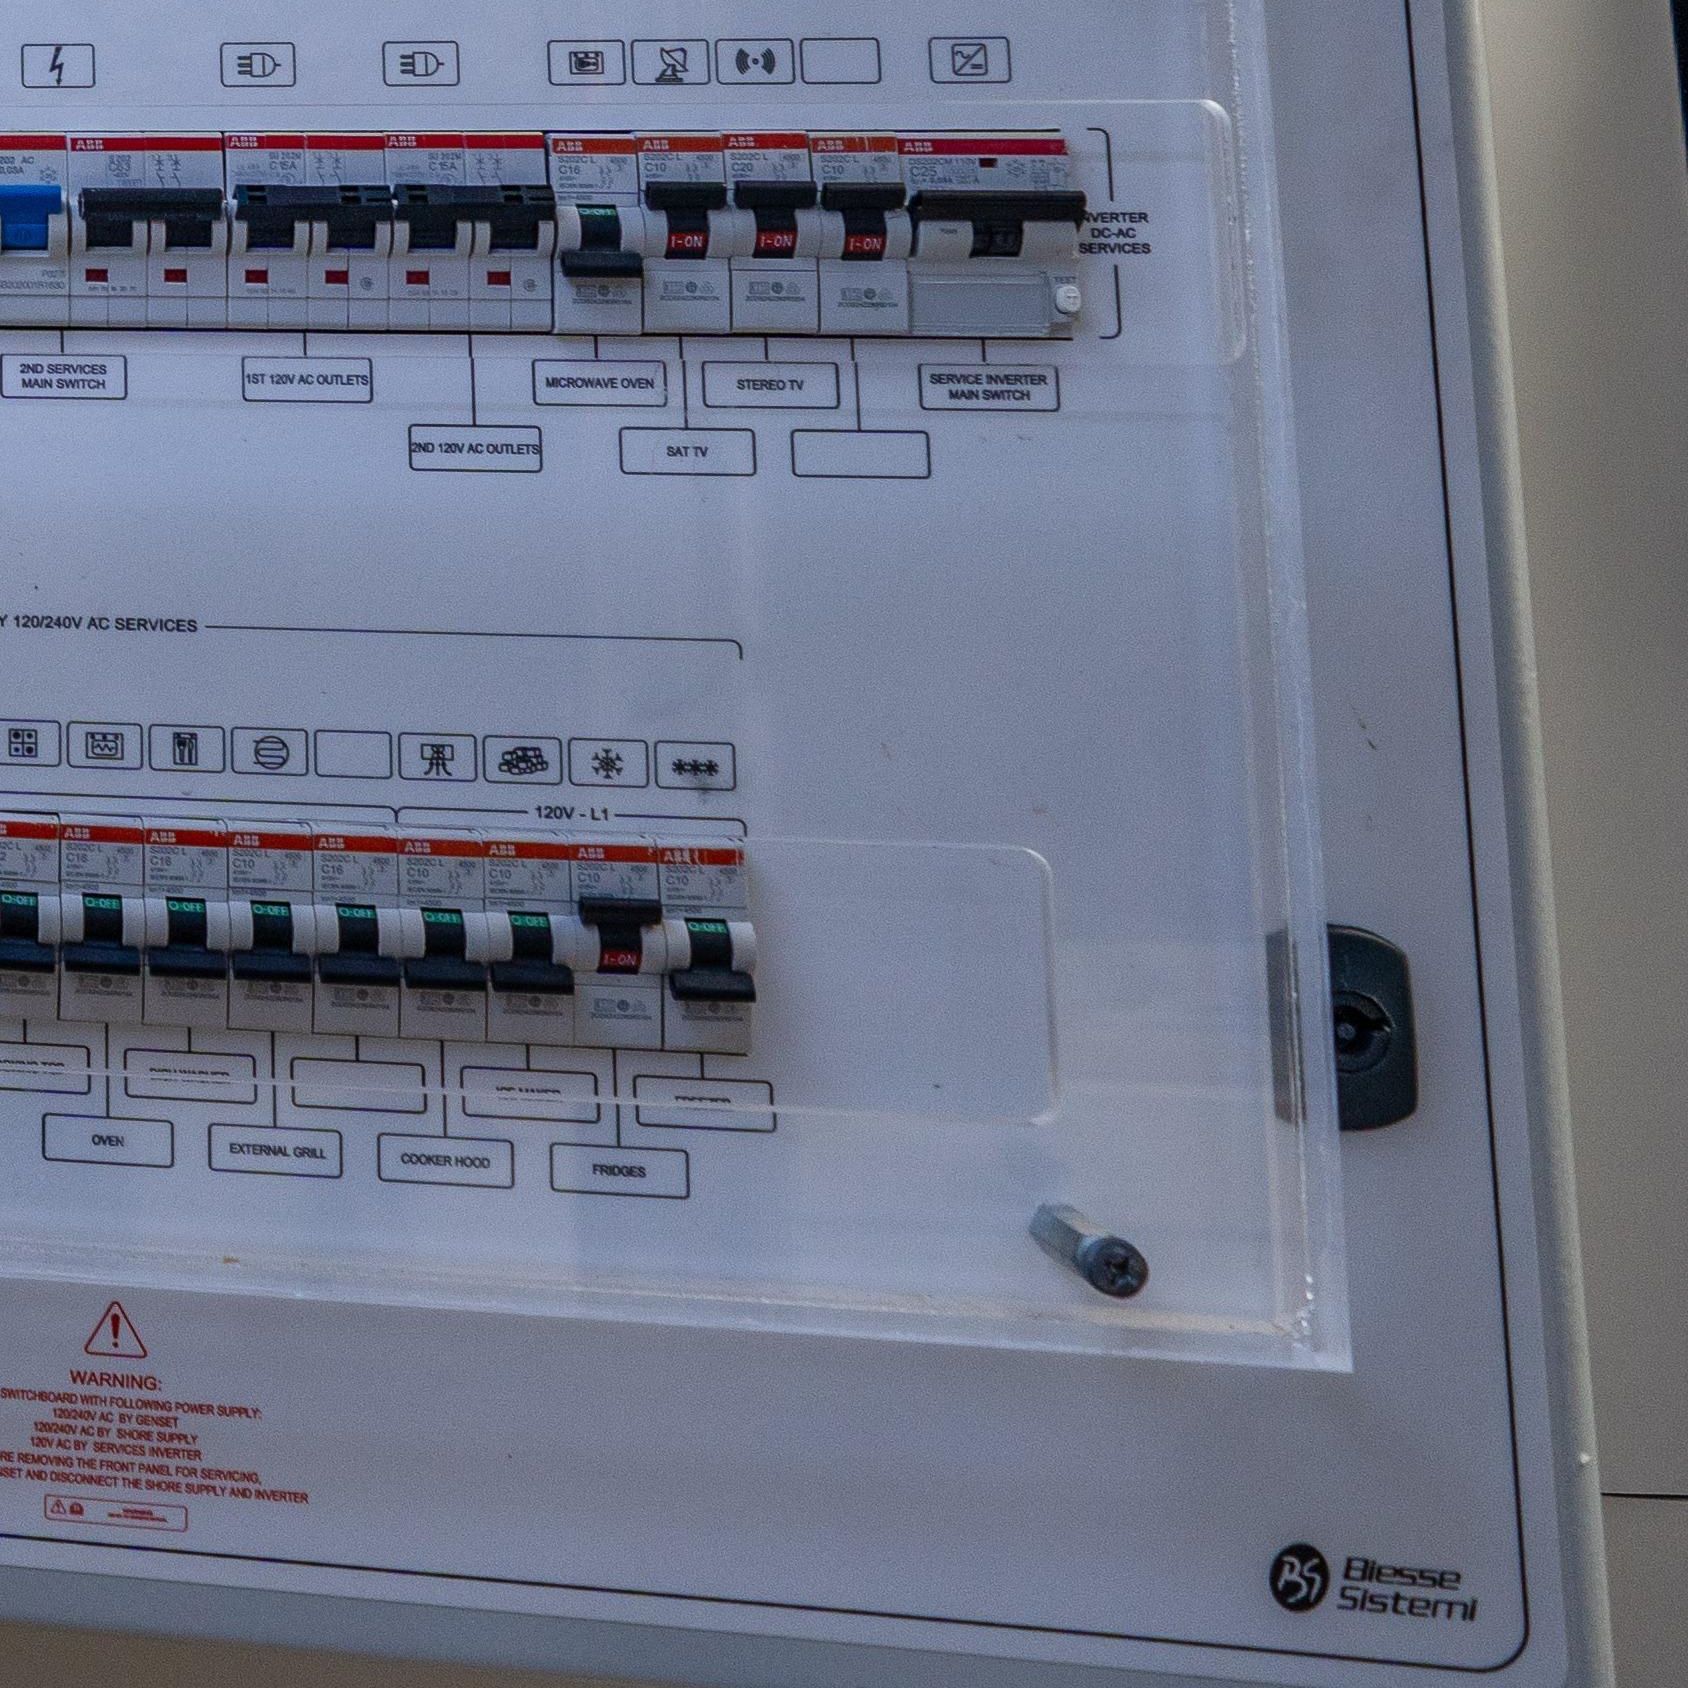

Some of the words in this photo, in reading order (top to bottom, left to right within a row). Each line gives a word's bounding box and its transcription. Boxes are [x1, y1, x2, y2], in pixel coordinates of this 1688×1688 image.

[1089, 227, 1136, 239] DC-AC
[1078, 239, 1151, 254] SERVICES
[546, 377, 618, 388] MICROWAVE
[621, 378, 654, 389] OVEN
[737, 379, 781, 390] STEREO
[784, 380, 804, 391] TV
[930, 373, 983, 385] SERVICE
[986, 374, 1047, 385] INVERTER
[667, 446, 689, 457] SAT
[692, 446, 708, 457] TV
[14, 615, 82, 629] 120/240V
[87, 617, 110, 630] AC
[115, 618, 198, 632] SERVICES
[535, 806, 575, 819] 120V
[591, 807, 609, 821] L1
[92, 1134, 124, 1146] OVEN
[401, 1153, 452, 1166] COOKER
[455, 1156, 490, 1169] HOOD
[593, 1164, 646, 1178] FRIDGES
[70, 1370, 162, 1391] WARNING:
[1337, 1586, 1477, 1621] Sistemi
